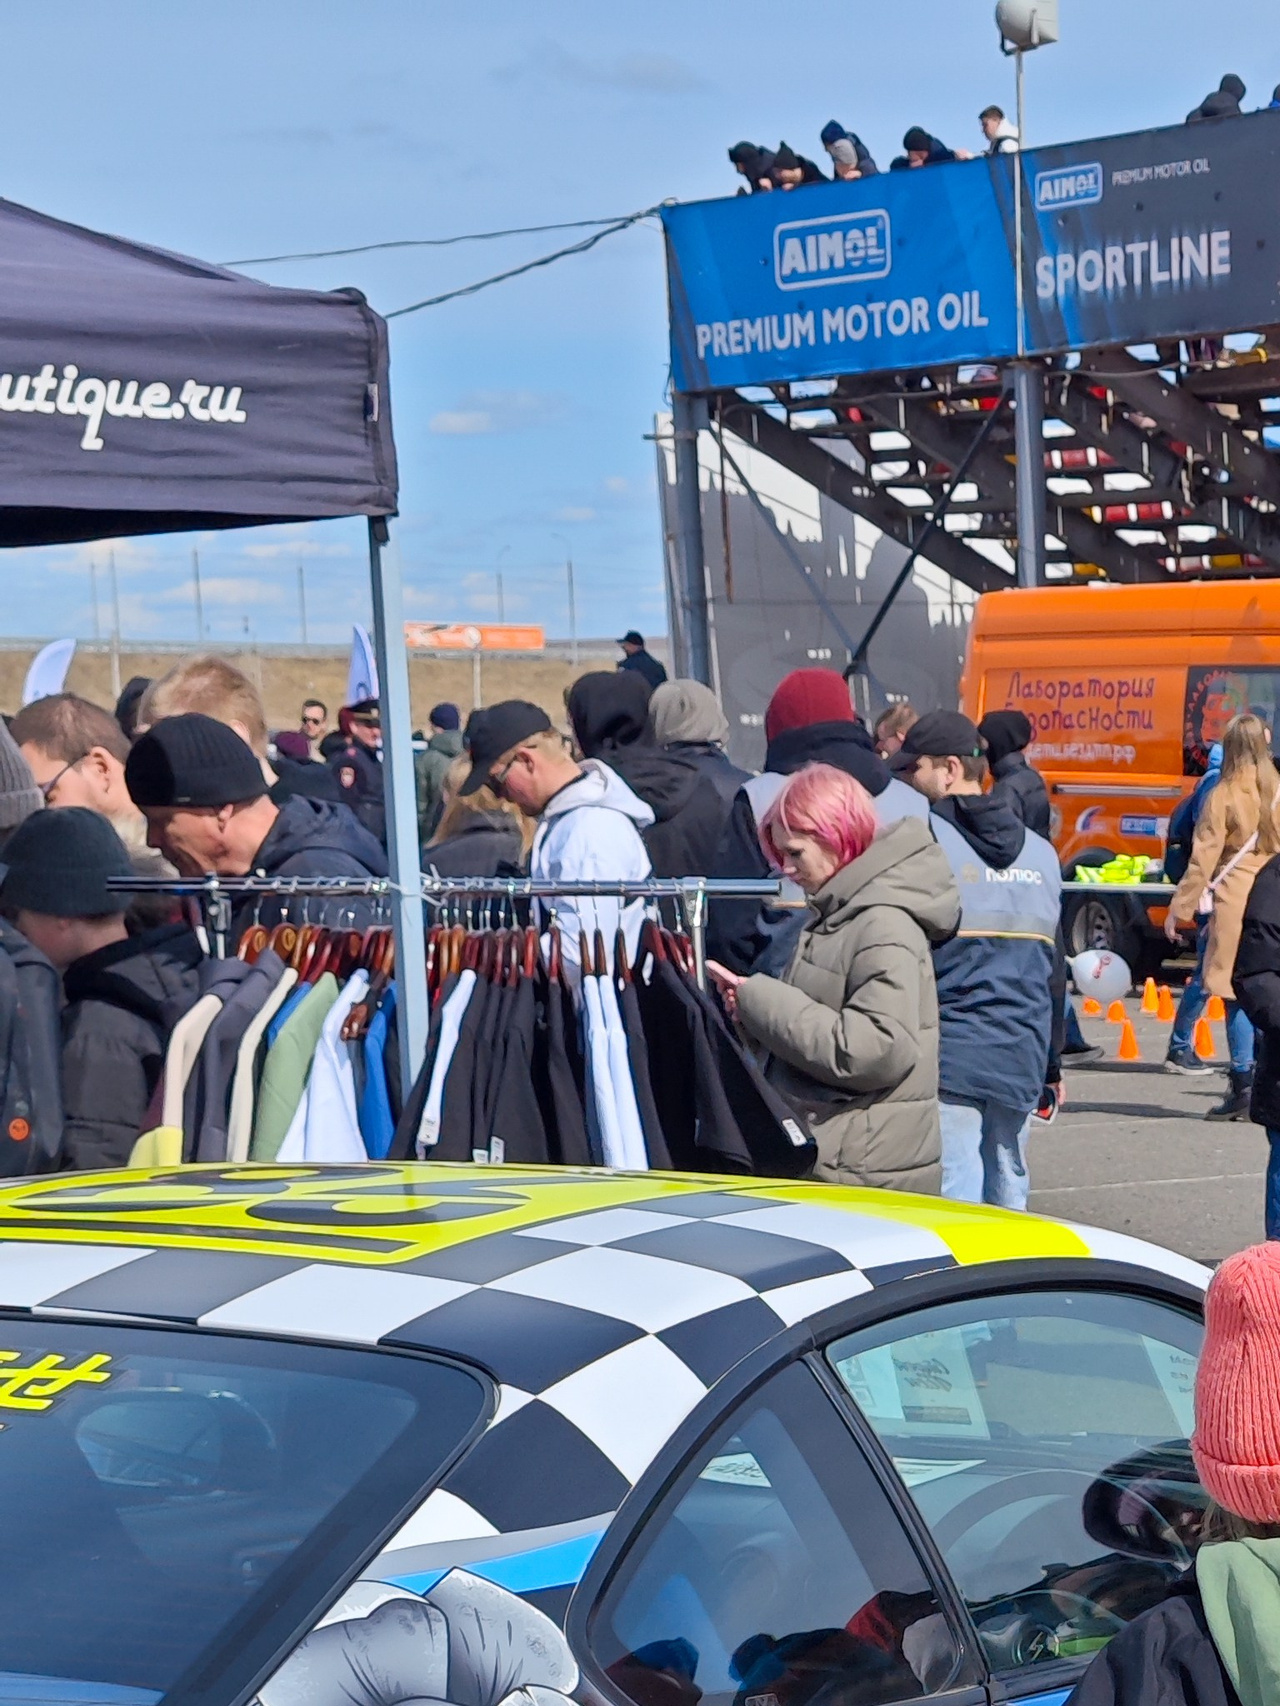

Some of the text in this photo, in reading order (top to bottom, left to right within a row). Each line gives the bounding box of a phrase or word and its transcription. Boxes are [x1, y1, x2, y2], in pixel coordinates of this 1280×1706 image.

[1039, 173, 1098, 203] AIMOL
[1154, 160, 1191, 180] MOTOR
[1192, 158, 1211, 174] OIL
[781, 225, 886, 277] AIMOL
[1036, 230, 1231, 298] SPORTLINE
[695, 289, 989, 361] PREMIUM MOTOR OIL
[1007, 671, 1156, 708] Лаборатория
